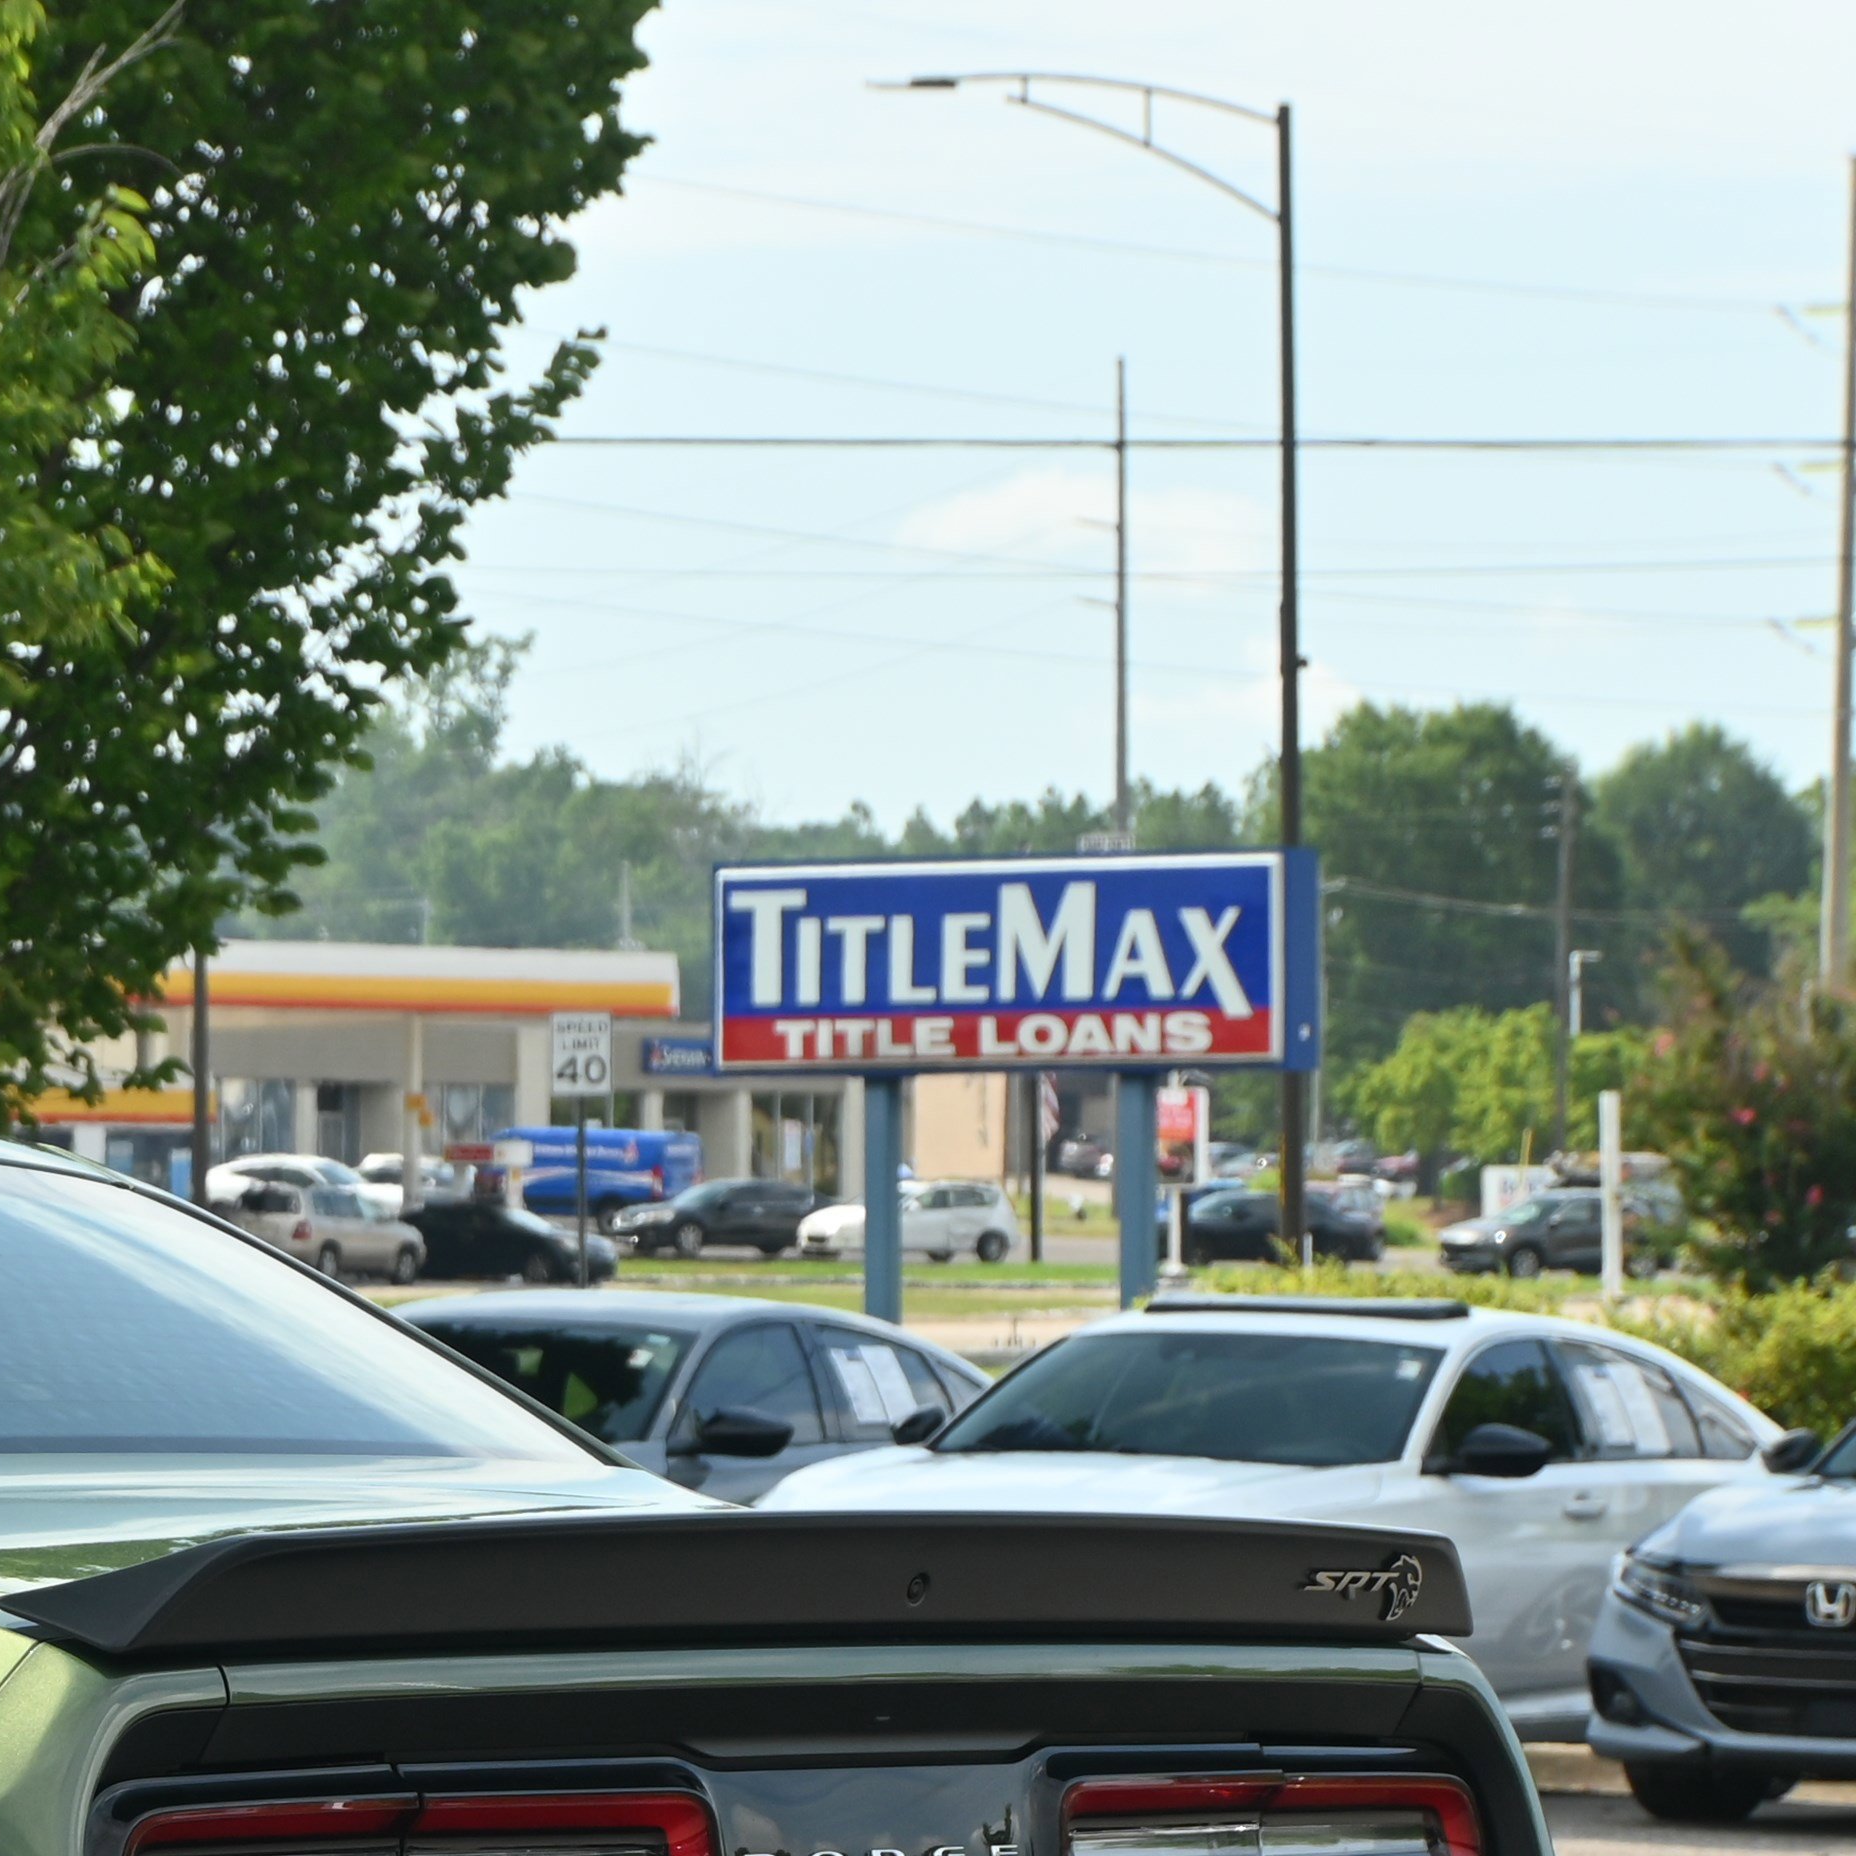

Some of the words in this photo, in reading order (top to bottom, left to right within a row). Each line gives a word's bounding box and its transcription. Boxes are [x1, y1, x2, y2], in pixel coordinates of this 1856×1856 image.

[555, 1020, 609, 1034] SPEED
[775, 1016, 956, 1060] TITLE
[980, 1010, 1213, 1056] LOANS
[562, 1037, 600, 1050] LIMIT
[556, 1055, 608, 1084] 40
[1303, 1571, 1400, 1601] SRT
